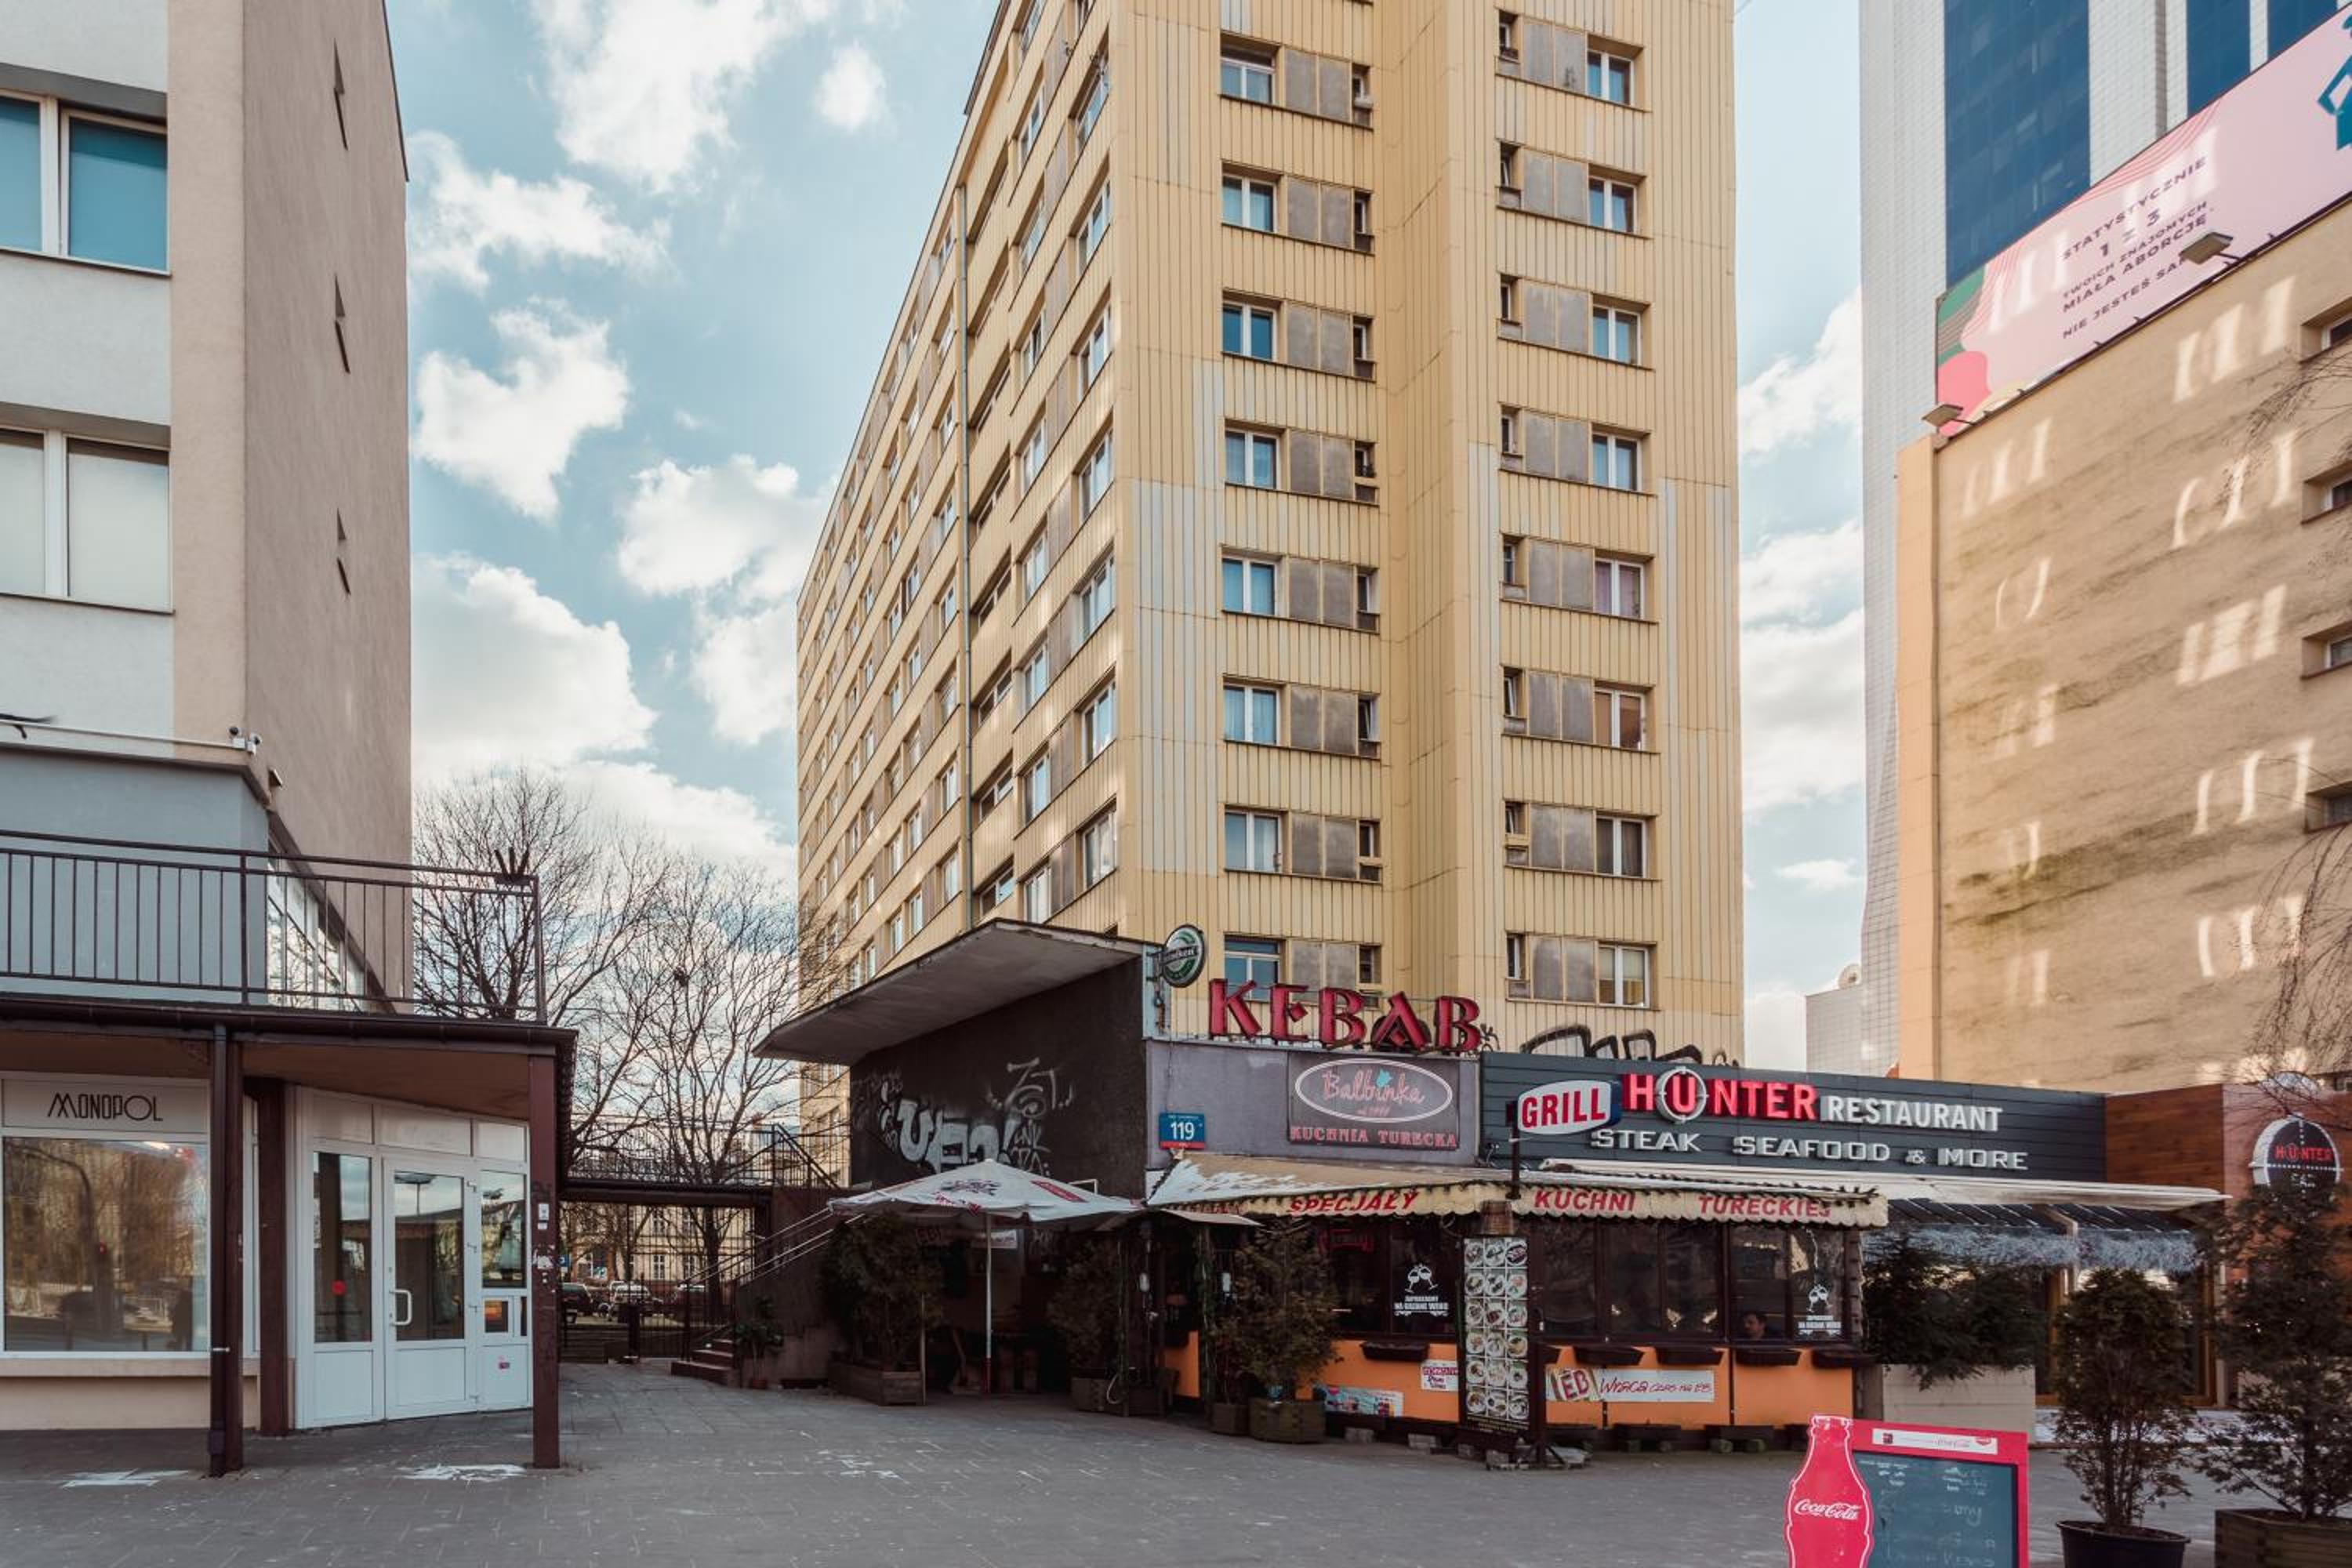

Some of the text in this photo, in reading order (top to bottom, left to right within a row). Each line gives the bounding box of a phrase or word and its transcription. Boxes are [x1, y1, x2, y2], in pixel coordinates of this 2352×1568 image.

[2063, 158, 2206, 260] STATYSTYCZNIE
[2063, 201, 2207, 299] TWOICH ZNAJOMYCH
[2099, 243, 2110, 258] 1
[2147, 209, 2161, 227] 3
[2063, 319, 2088, 339] NIE
[1208, 978, 1482, 1053] KEBAB
[47, 1092, 164, 1122] MONOPOL
[1521, 1087, 1606, 1128] GRILL
[1623, 1069, 2004, 1132] HUNTER RESTAURANT
[1171, 1121, 1195, 1141] 119
[1290, 1126, 1457, 1147] KUCHNIA TURECKA
[1591, 1129, 2029, 1171] STEAK SEAFOOD & MORE
[1534, 1190, 1635, 1212] KUCHNI
